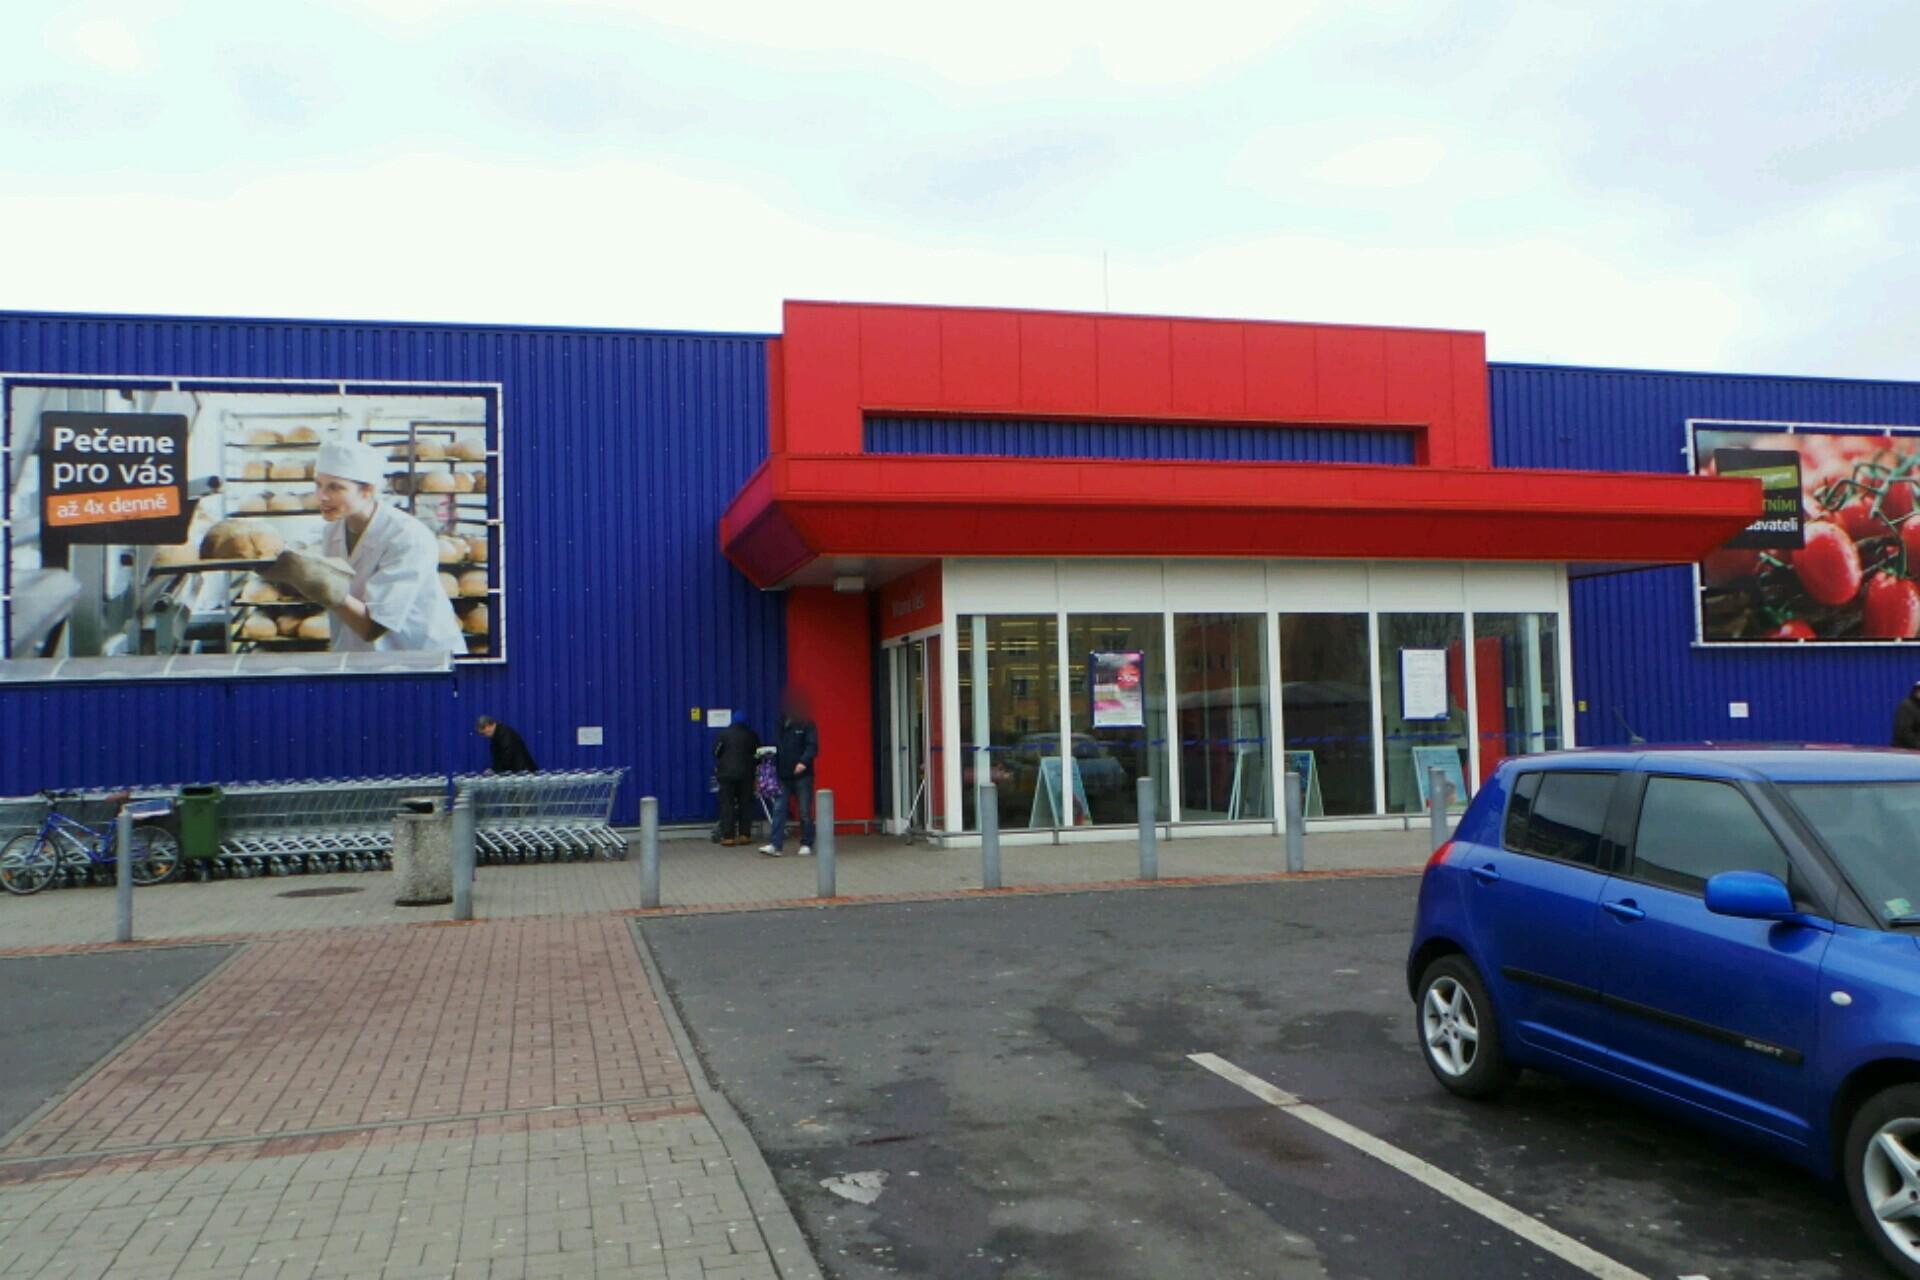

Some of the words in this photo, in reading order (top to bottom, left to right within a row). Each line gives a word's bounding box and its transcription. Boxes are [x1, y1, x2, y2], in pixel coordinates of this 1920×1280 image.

[53, 427, 175, 454] Pečeme
[53, 463, 109, 490] pro
[118, 457, 175, 485] vás
[57, 501, 80, 518] až
[84, 499, 105, 515] 4x
[109, 493, 168, 514] denně
[1745, 517, 1798, 532] avateli
